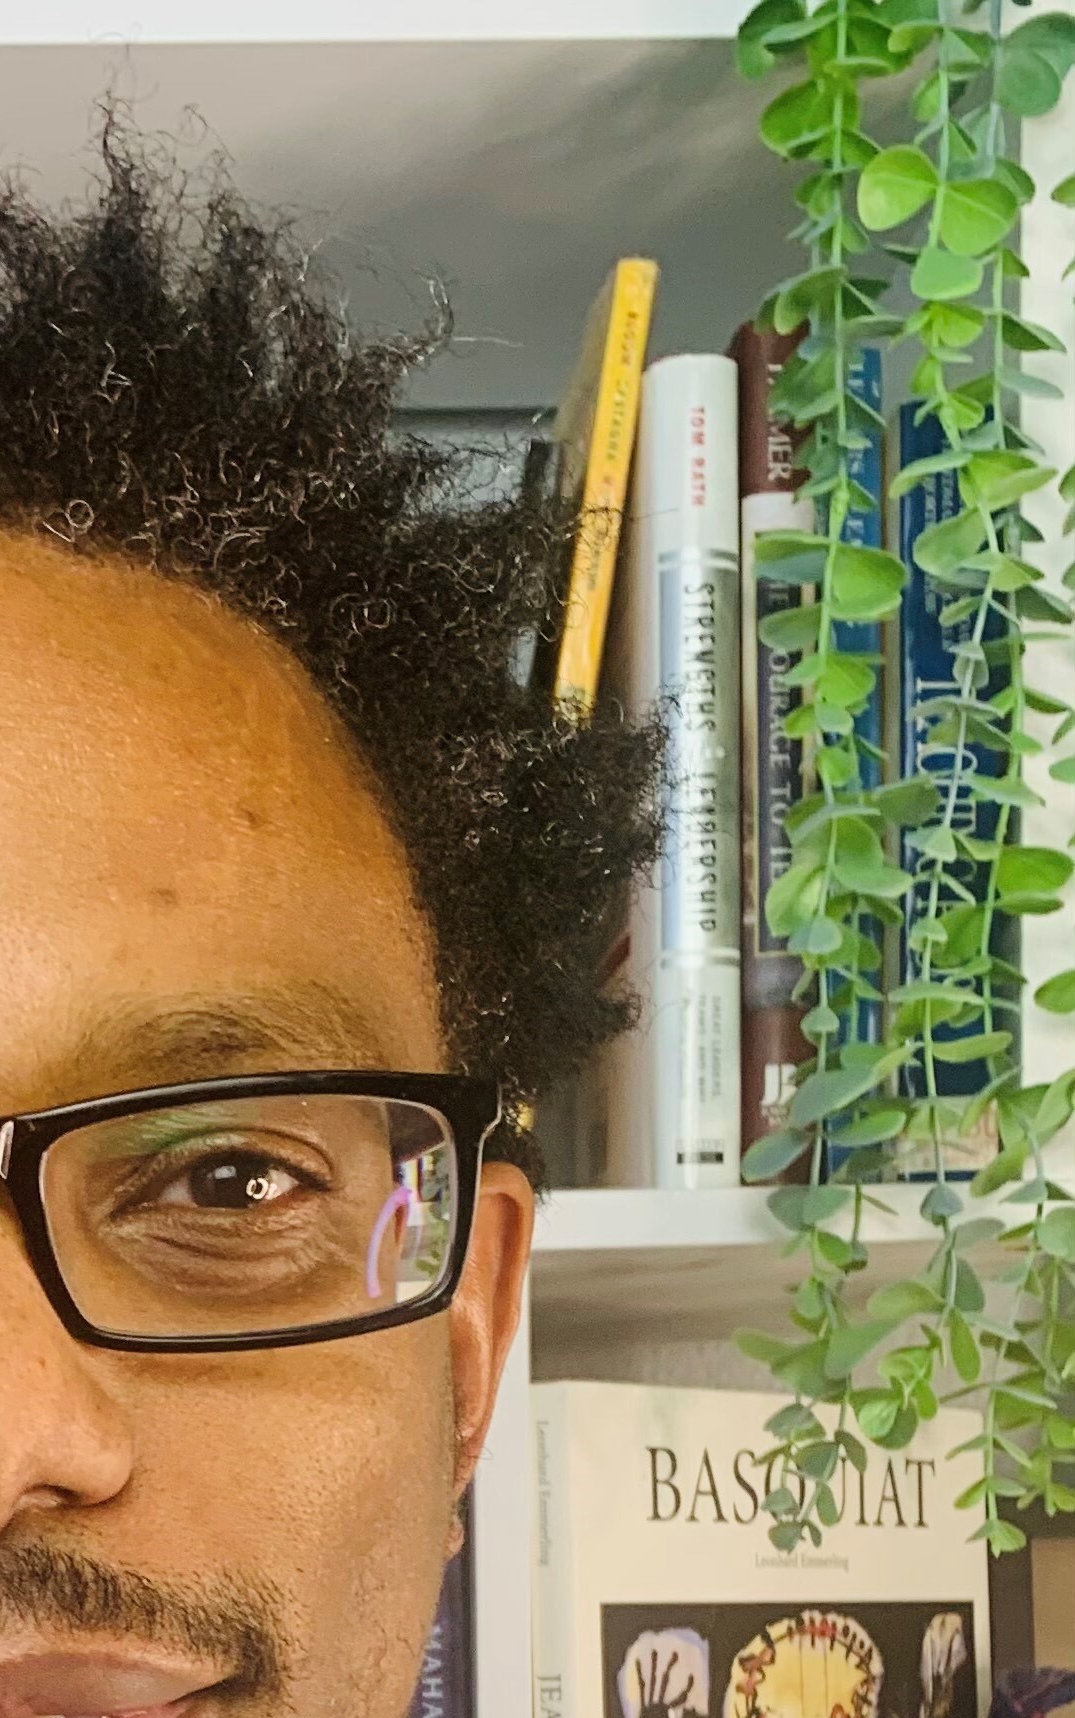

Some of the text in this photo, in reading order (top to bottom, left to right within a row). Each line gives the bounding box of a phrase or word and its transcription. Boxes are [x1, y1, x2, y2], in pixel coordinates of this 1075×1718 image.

[691, 406, 707, 507] TOM RATH
[684, 582, 717, 733] STRENGTHS
[767, 650, 792, 769] OURAGE
[769, 783, 793, 826] TO
